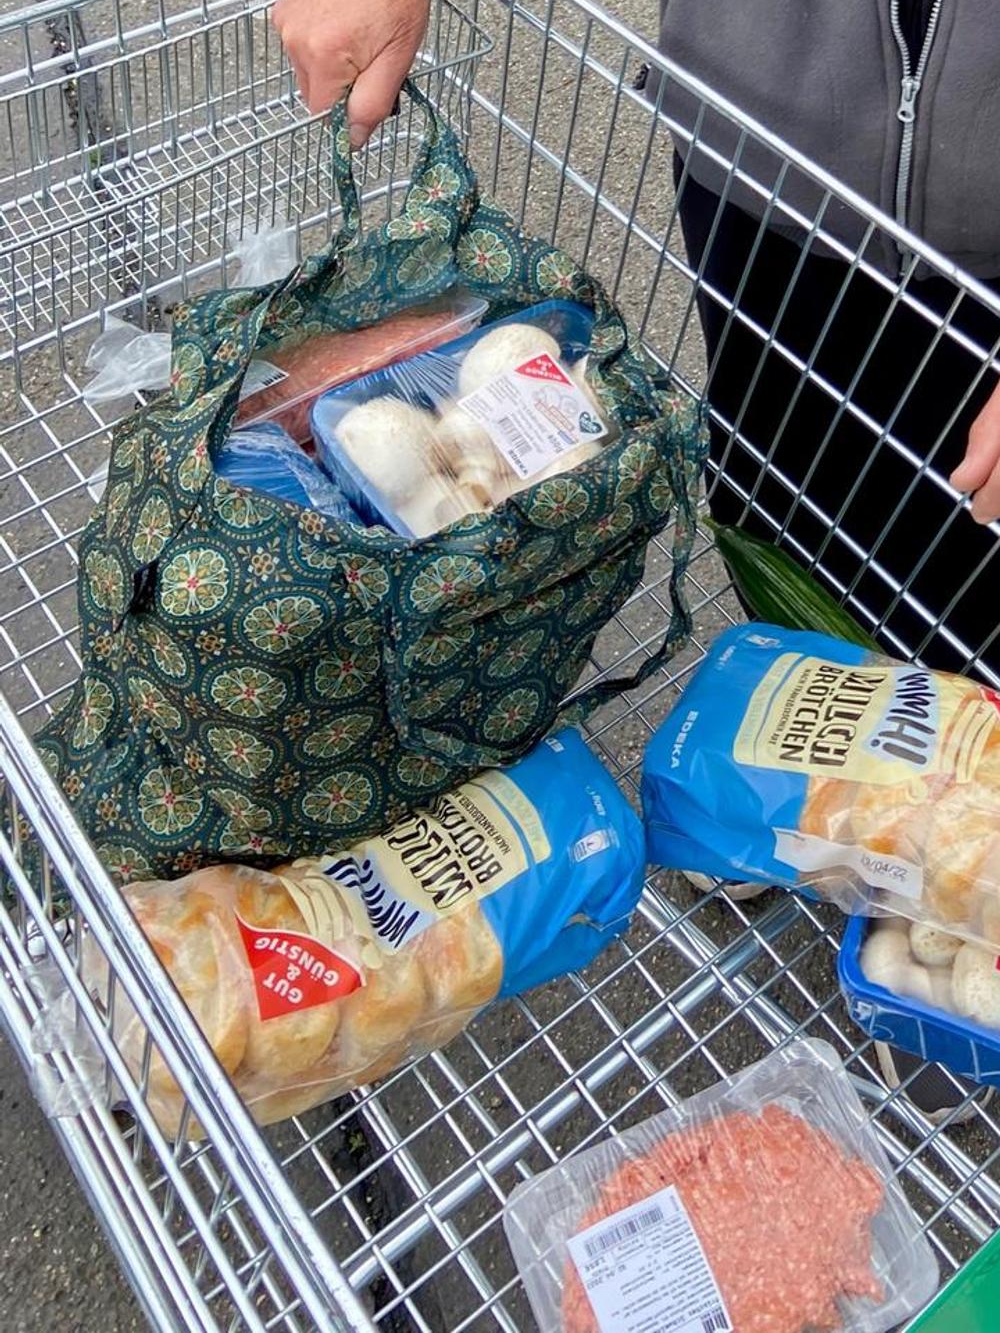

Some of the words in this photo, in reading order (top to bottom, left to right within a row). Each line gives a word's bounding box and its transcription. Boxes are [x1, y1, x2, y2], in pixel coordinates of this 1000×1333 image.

[671, 710, 699, 768] EDEKA
[780, 665, 845, 762] BRÖTCHEN
[808, 670, 889, 767] MILCH
[254, 936, 340, 987] GÜNSTIG
[262, 971, 304, 1004] GUT
[286, 962, 302, 981] &
